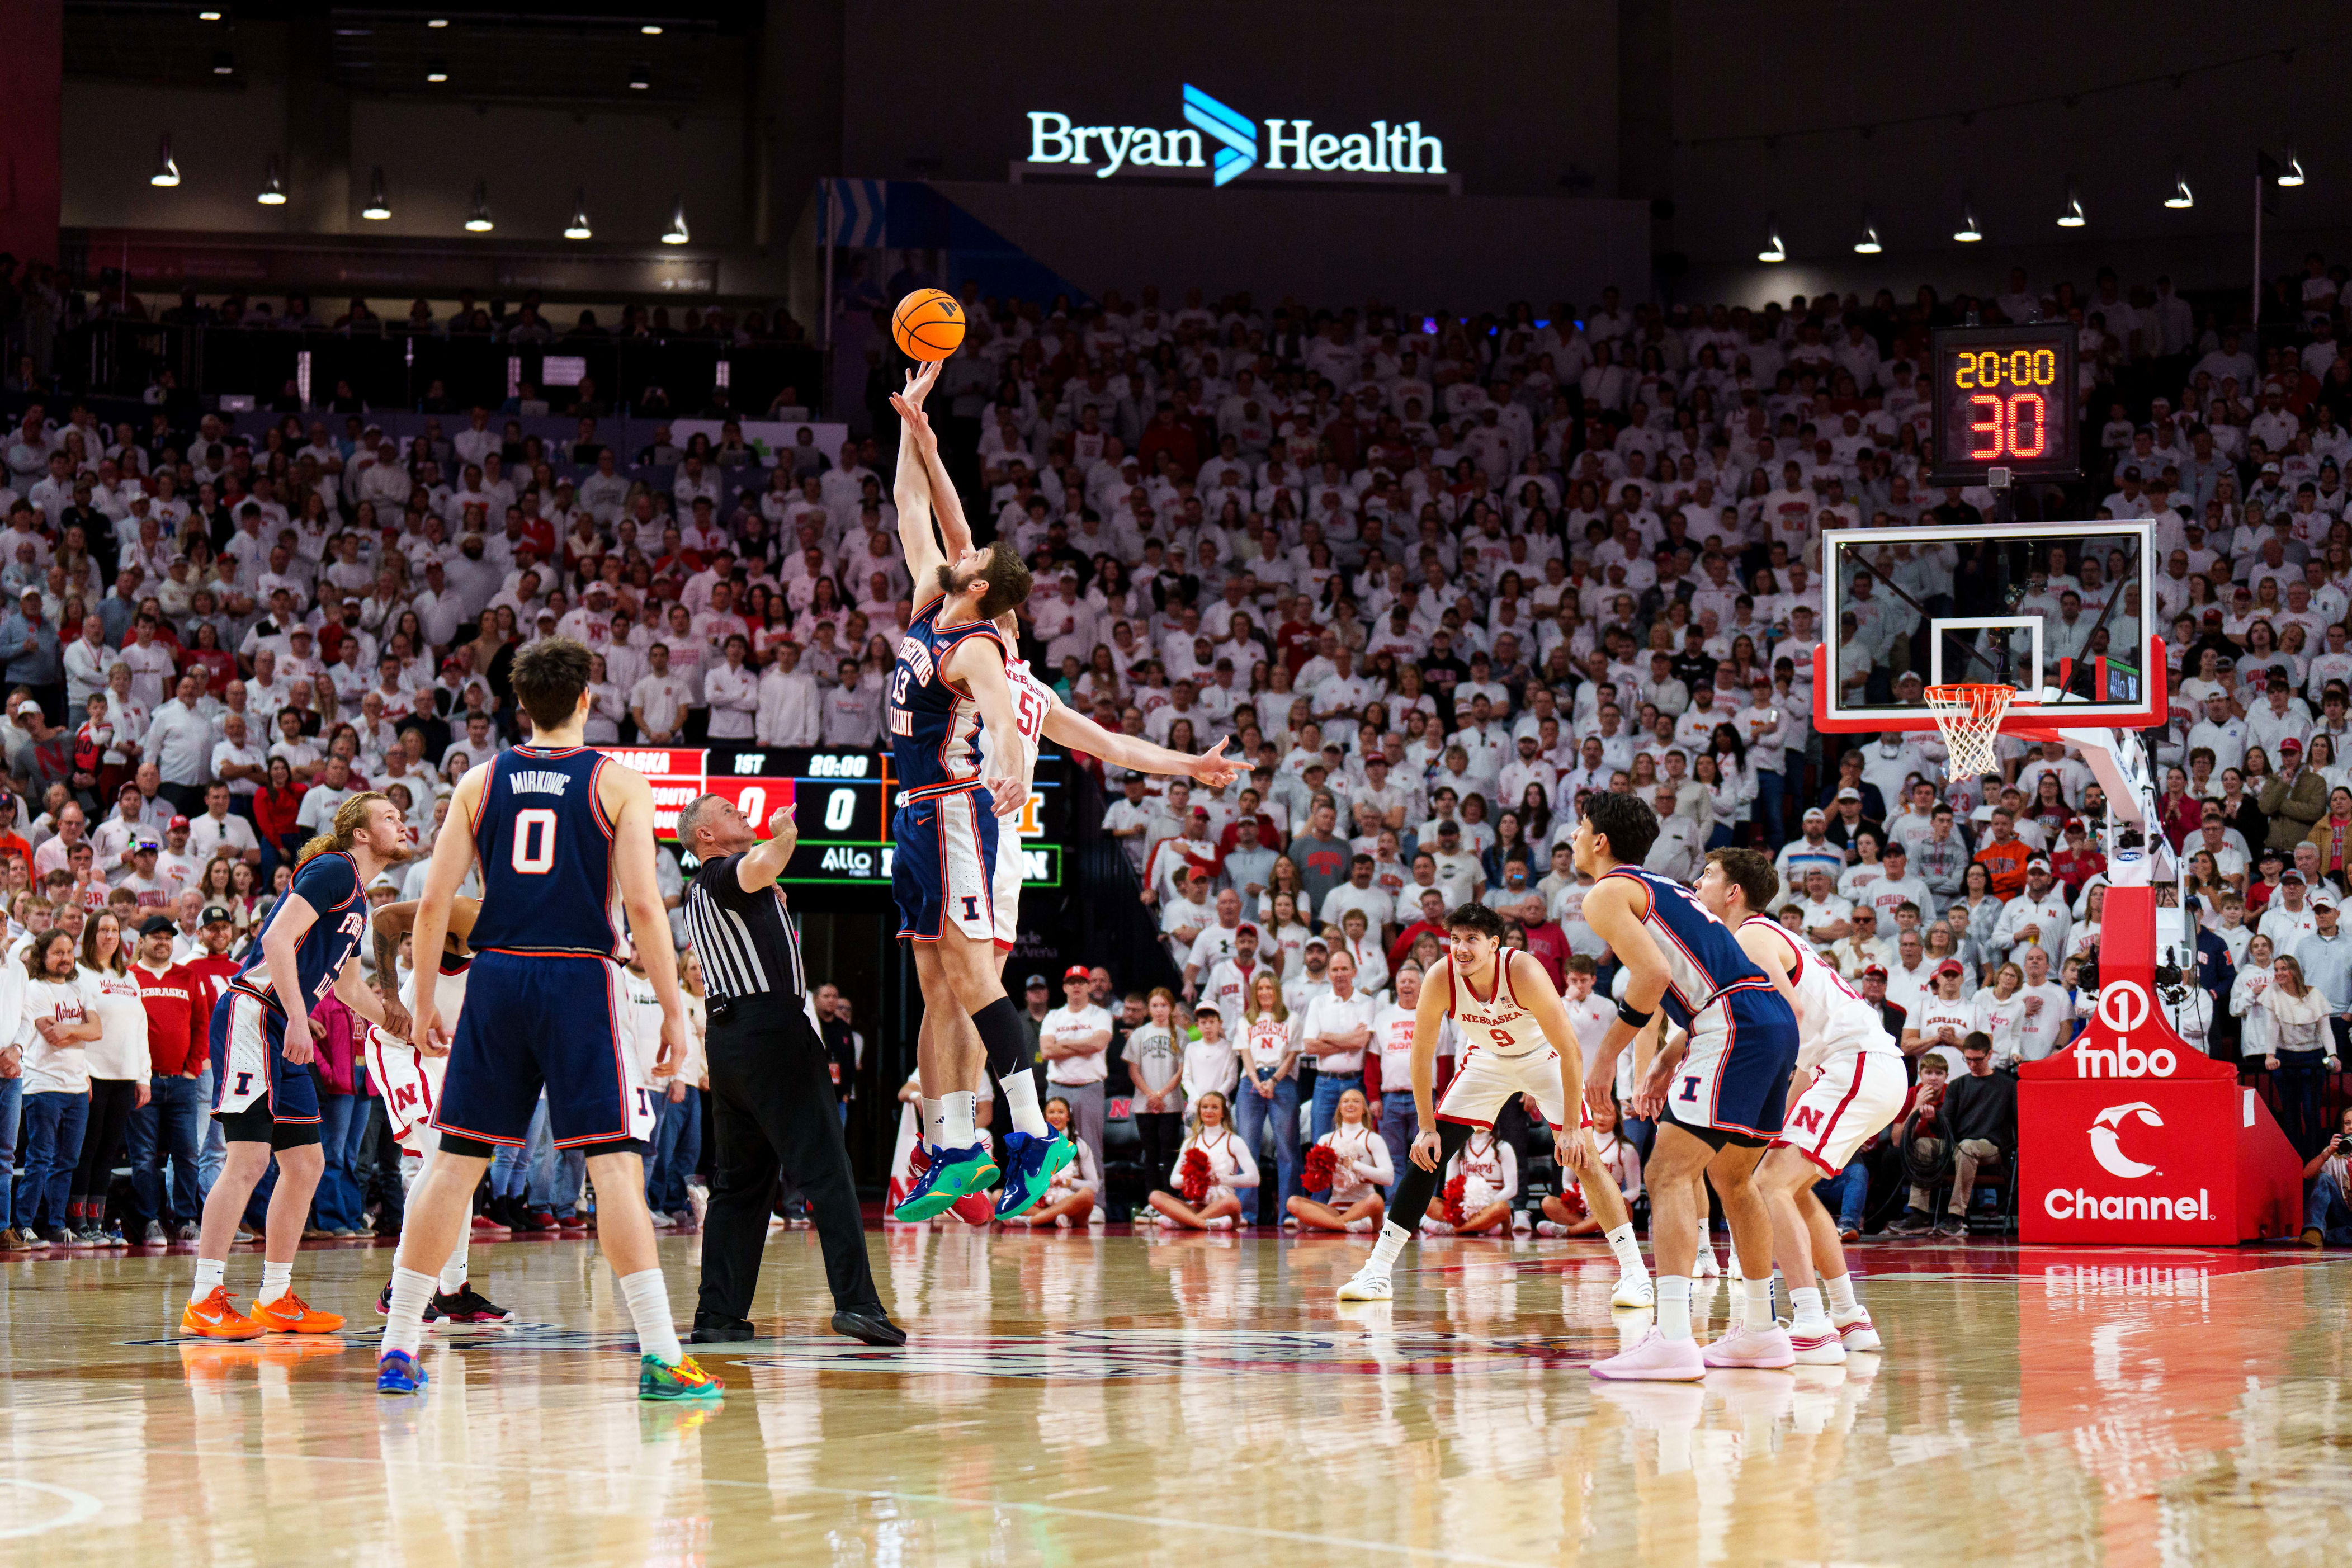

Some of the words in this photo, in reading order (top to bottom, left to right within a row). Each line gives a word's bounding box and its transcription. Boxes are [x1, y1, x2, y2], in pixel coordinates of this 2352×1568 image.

[1027, 111, 1206, 178] Bryan
[1264, 119, 1447, 174] Health
[1956, 349, 2055, 389] 20:00
[1970, 393, 2044, 460] 30
[898, 636, 934, 688] FIGHTING
[892, 664, 911, 706] 13
[1017, 689, 1042, 744] 51
[734, 753, 767, 774] 1ST
[808, 754, 868, 777] 20:00
[509, 771, 571, 796] MIRKOVIC
[824, 788, 856, 831] 0
[511, 809, 557, 874] 0
[2048, 909, 2057, 918] N
[100, 979, 134, 991] Nebraska
[1248, 1019, 1289, 1045] NEBRASKA
[1461, 1010, 1523, 1027] NEBRASKA
[1926, 1016, 1968, 1029] NEBRASKA
[1262, 1037, 1273, 1049] N
[1489, 1029, 1515, 1047] 9
[2073, 1037, 2177, 1078] fnbo
[395, 1083, 419, 1112] N
[1108, 1099, 1132, 1118] N
[1793, 1105, 1825, 1135] N
[2044, 1188, 2208, 1221] Channel
